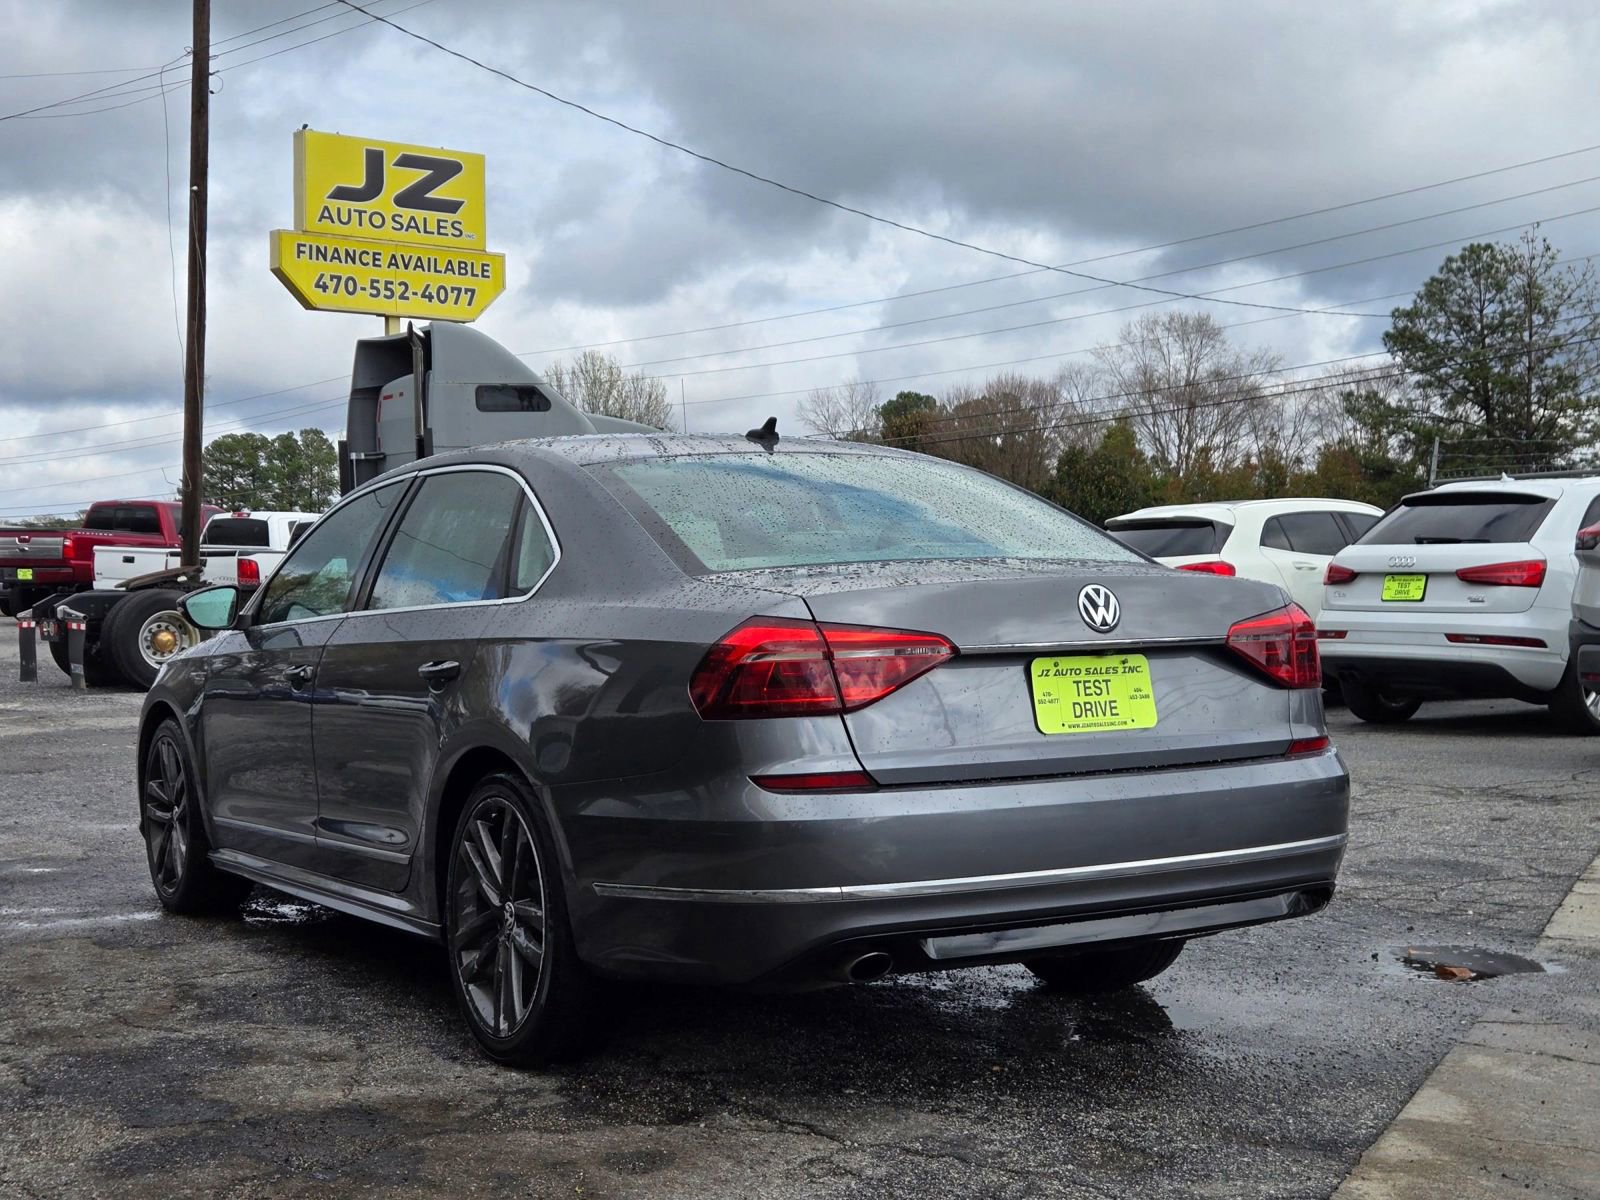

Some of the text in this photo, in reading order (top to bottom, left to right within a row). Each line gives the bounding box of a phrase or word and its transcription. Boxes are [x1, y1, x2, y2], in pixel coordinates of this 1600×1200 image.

[326, 148, 465, 214] JZ
[317, 205, 386, 229] AUTO
[391, 213, 463, 238] SALES
[296, 243, 491, 279] FINANCE AVAILABLE
[314, 272, 476, 306] 470-552-4077
[1037, 668, 1051, 677] JZ
[1053, 667, 1082, 677] AUTO
[1084, 666, 1118, 676] SALES
[1072, 679, 1111, 697] TEST
[1072, 700, 1120, 719] DRIVE
